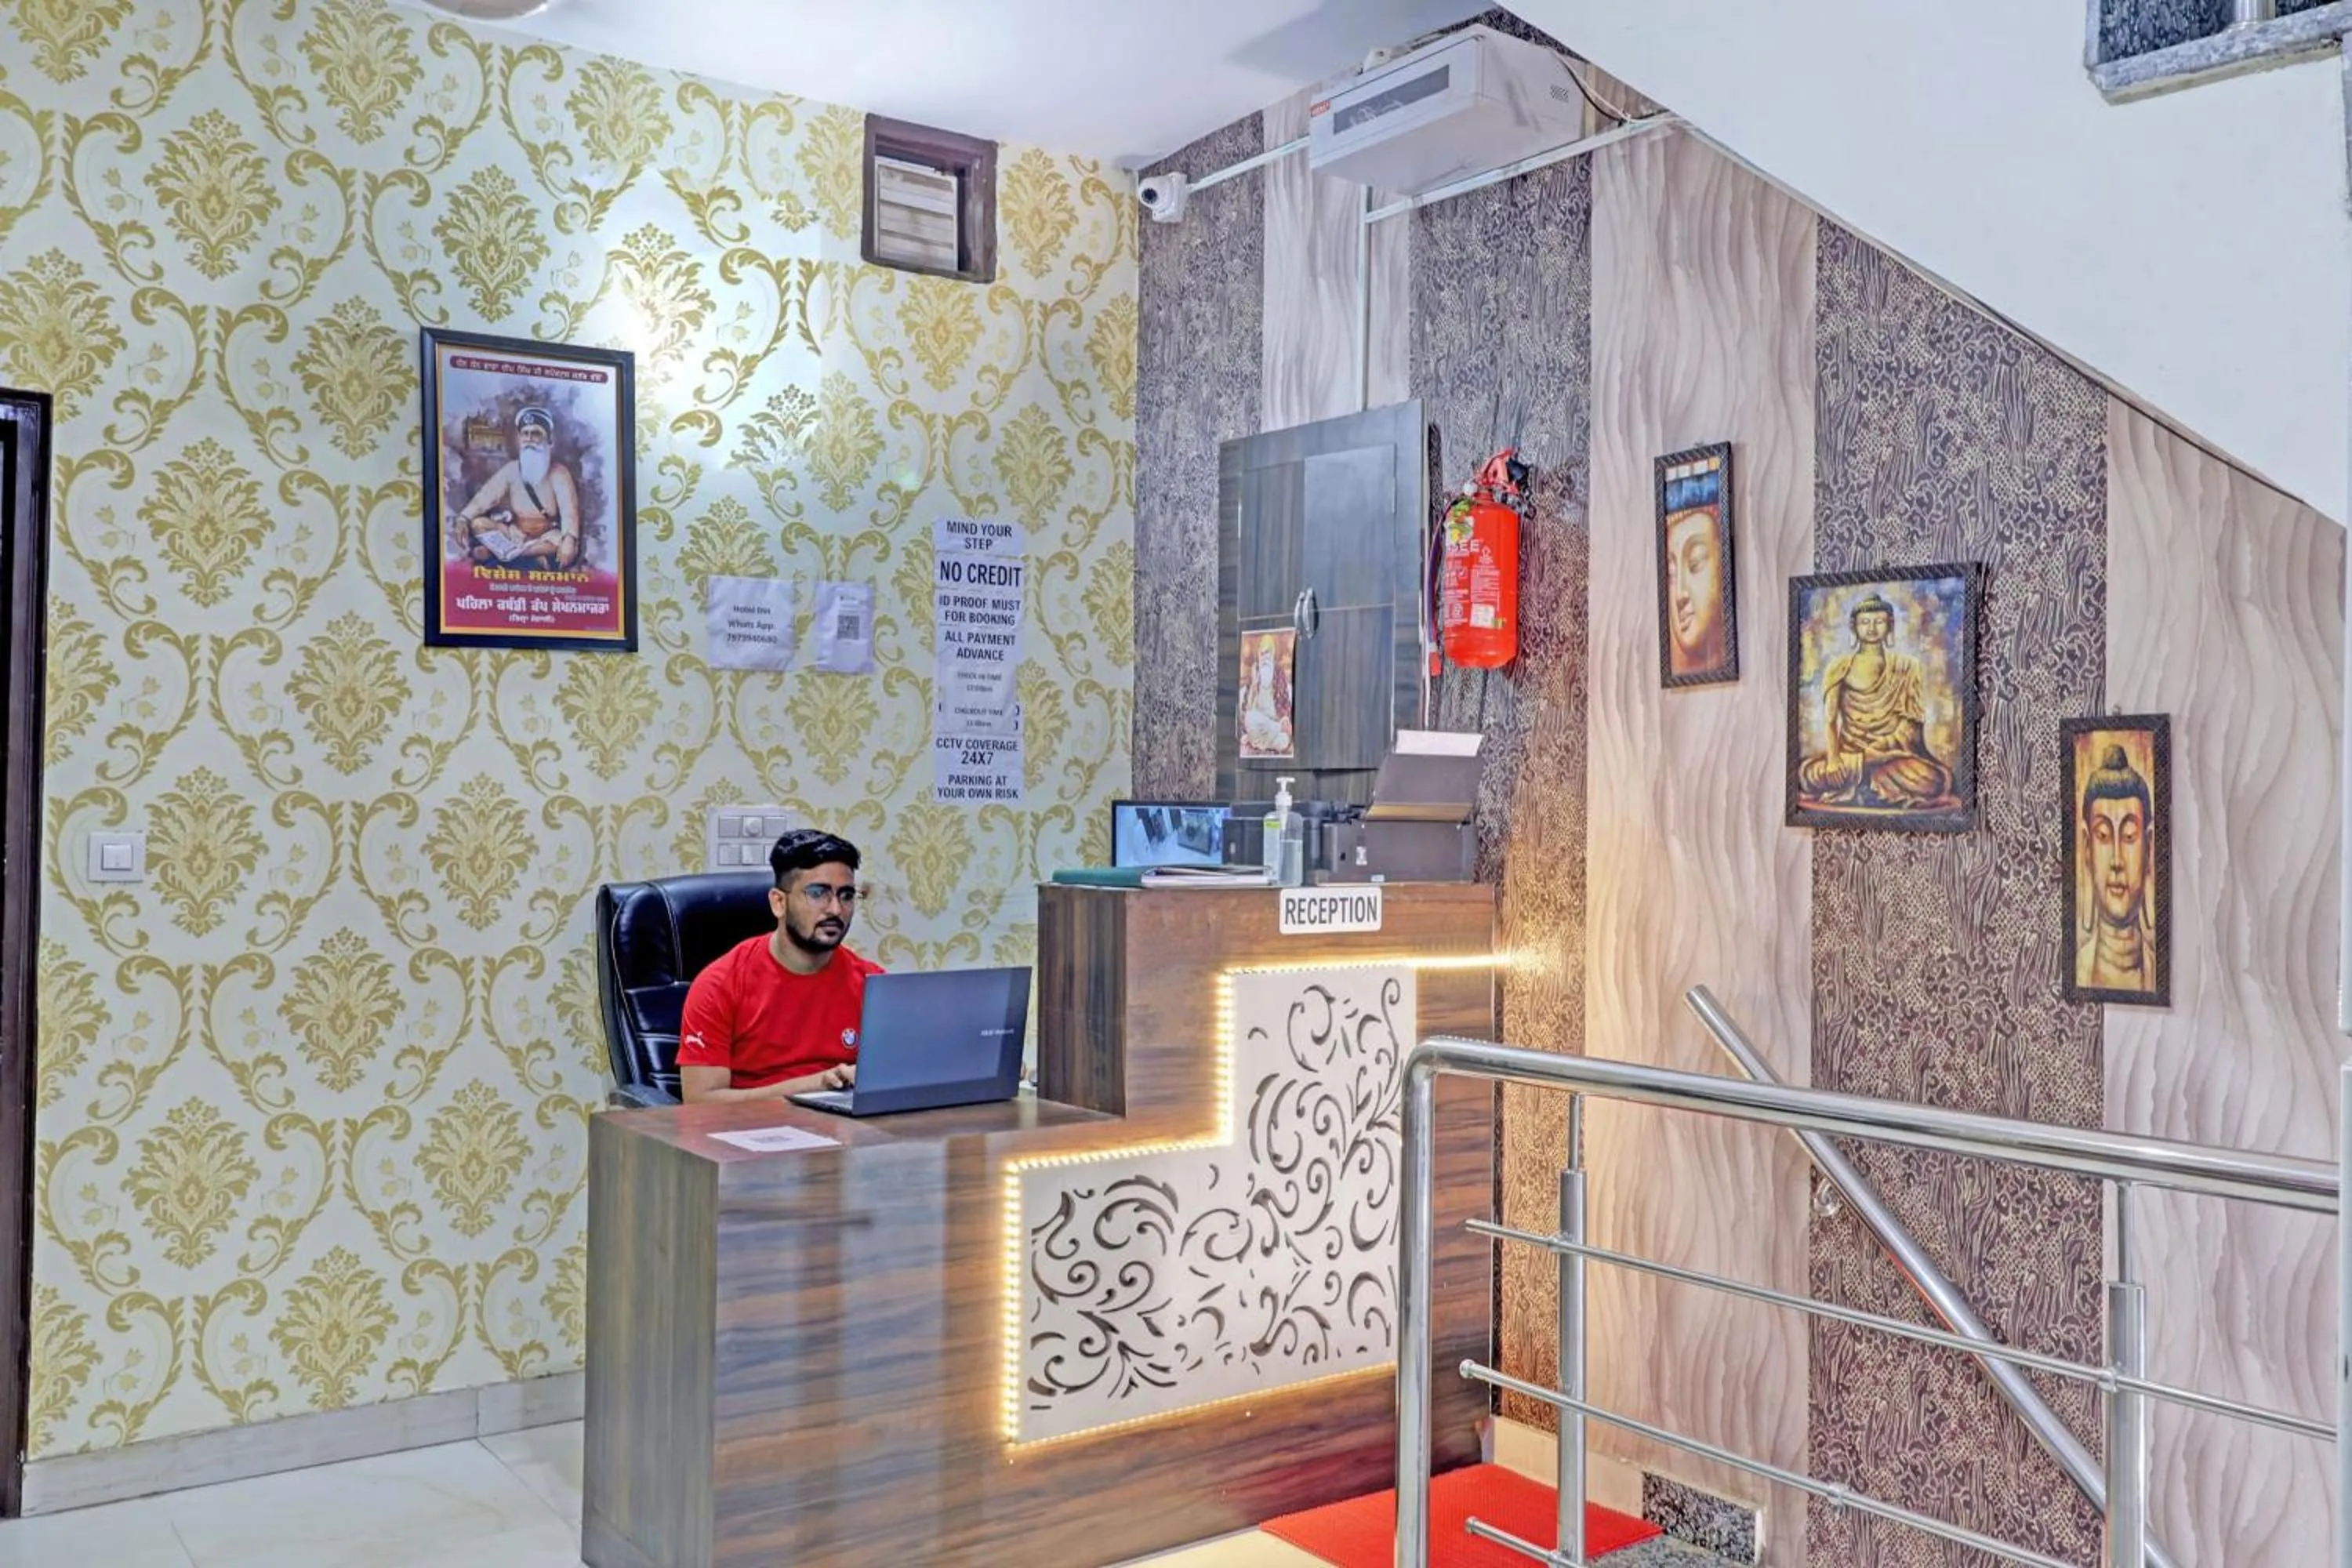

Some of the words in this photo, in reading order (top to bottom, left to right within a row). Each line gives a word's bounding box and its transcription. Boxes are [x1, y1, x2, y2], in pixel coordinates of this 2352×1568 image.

[946, 521, 978, 535] MIND
[981, 523, 1012, 537] YOUR
[965, 537, 993, 550] STEP
[940, 560, 962, 583] NO
[967, 563, 1022, 587] CREDIT
[939, 595, 950, 606] ID
[953, 596, 988, 608] PROOF
[992, 598, 1021, 611] MUST
[945, 611, 966, 622] FOR
[969, 612, 1015, 626] BOOKING
[945, 630, 964, 643] ALL
[967, 632, 1016, 646] PAYMENT
[956, 648, 1004, 661] ADVANCE
[935, 737, 963, 750] CCTV
[965, 739, 1019, 752] COVERAGE
[961, 750, 994, 765] 24X7
[948, 774, 992, 786] PARKING
[995, 775, 1007, 786] AT
[937, 788, 965, 799] YOUR
[968, 788, 993, 799] OWN
[995, 788, 1018, 799] RISK
[1285, 896, 1377, 925] RECEPTION
